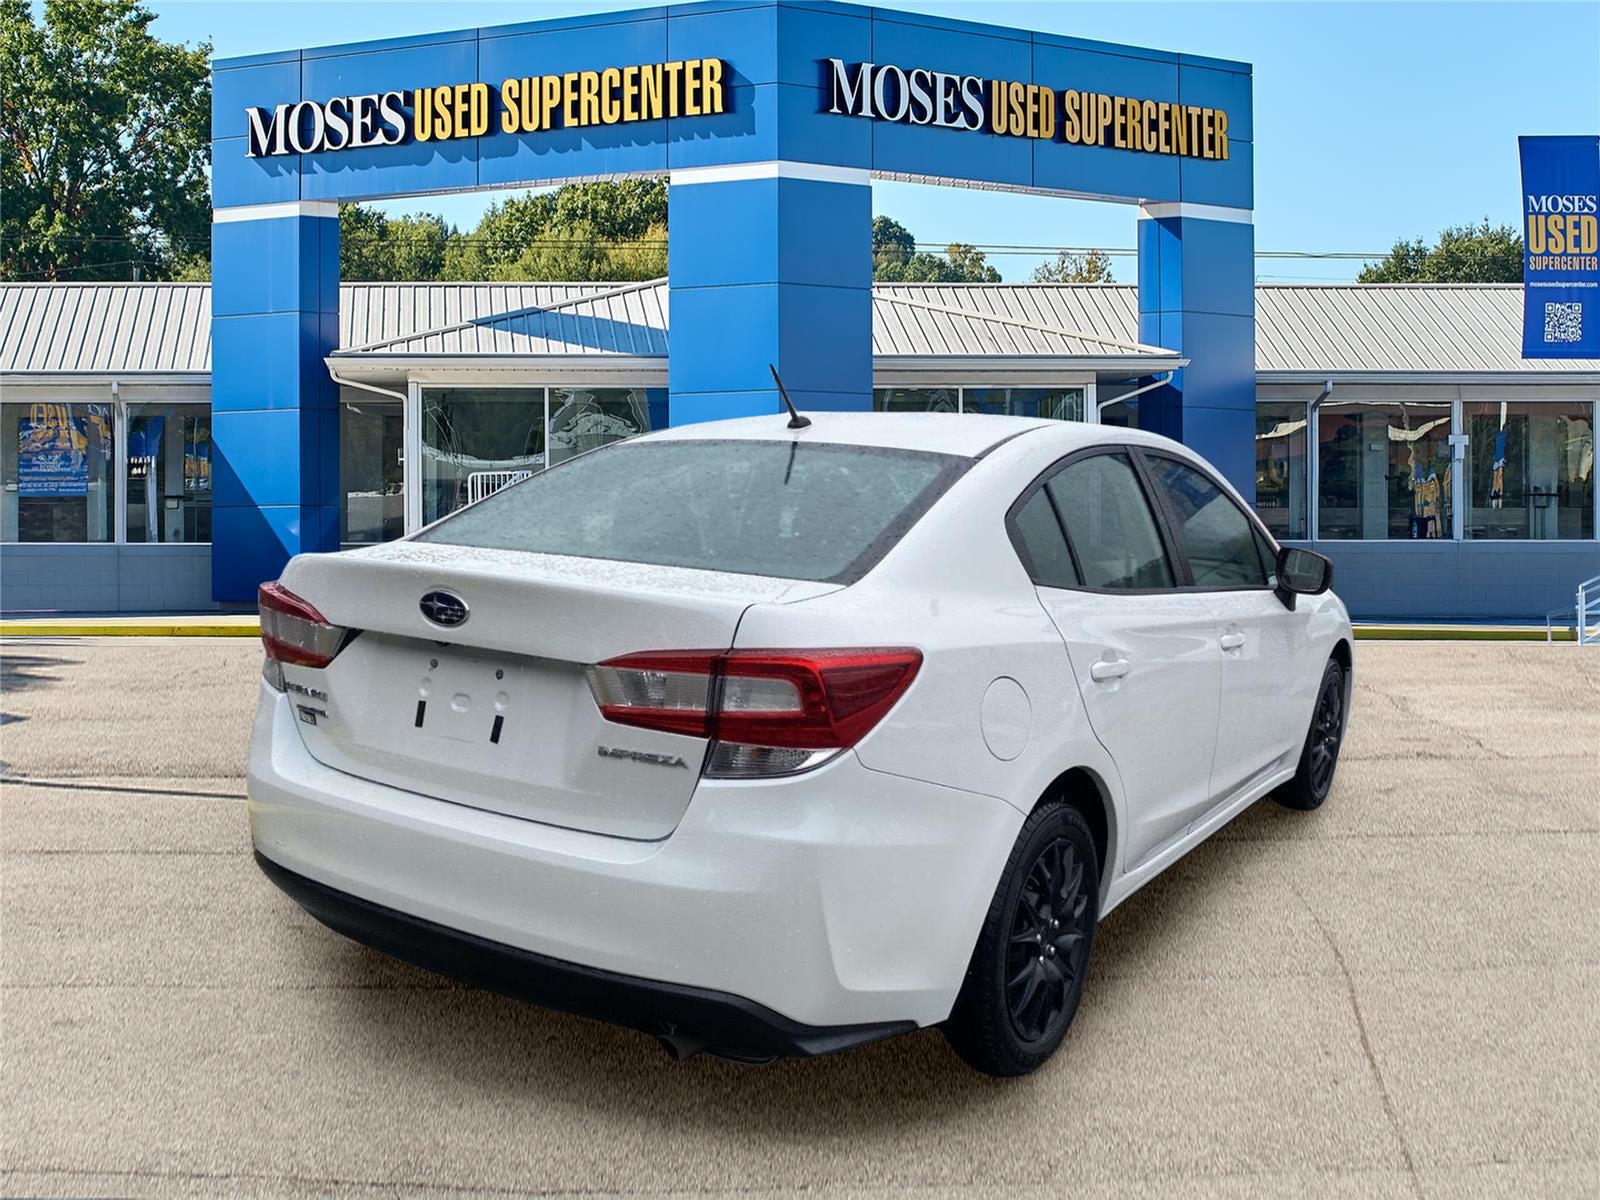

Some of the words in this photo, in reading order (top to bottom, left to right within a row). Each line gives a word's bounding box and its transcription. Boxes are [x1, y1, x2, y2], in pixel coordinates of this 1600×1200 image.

[244, 91, 407, 158] MOSES
[413, 82, 489, 142] USED
[500, 57, 725, 135] SUPERCENTER
[828, 58, 985, 131] MOSES
[991, 79, 1055, 139] USED
[1064, 89, 1229, 160] SUPERCENTER
[1528, 195, 1597, 213] MOSES
[1528, 214, 1598, 254] USED
[1529, 256, 1598, 271] SUPERCENTER
